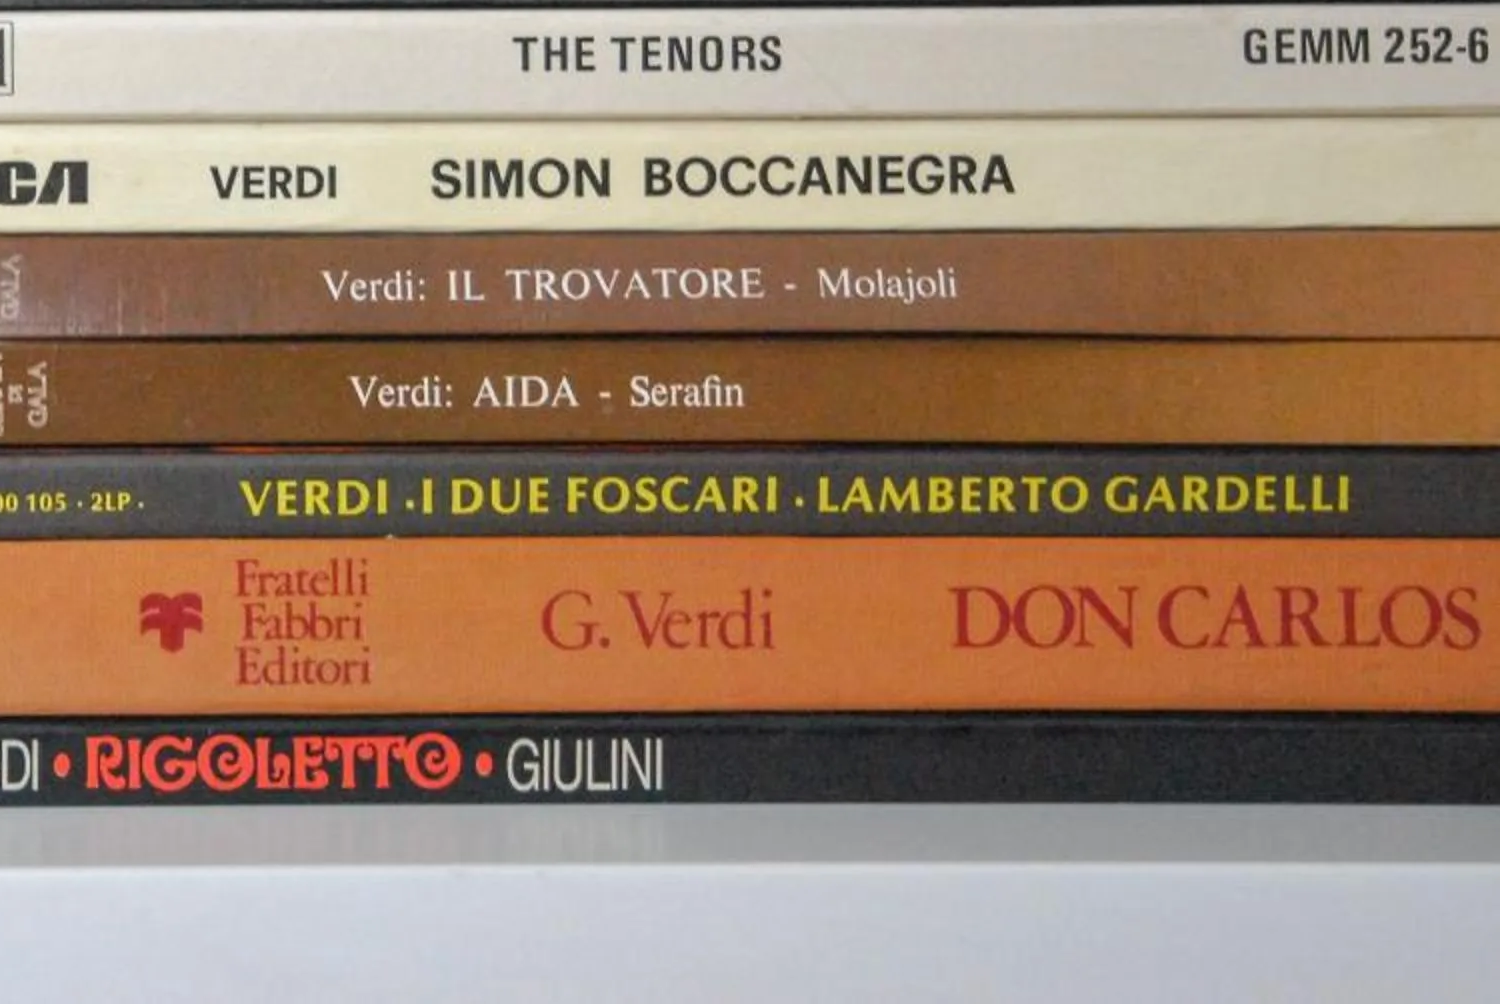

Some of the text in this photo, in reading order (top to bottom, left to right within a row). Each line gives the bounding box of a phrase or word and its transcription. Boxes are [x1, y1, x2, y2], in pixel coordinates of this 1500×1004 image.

[512, 27, 1490, 73] THE TENORS GEMM 252-6
[210, 155, 1016, 200] VERDI SIMON BOCCANEGRA
[1, 254, 23, 319] GALA
[322, 267, 958, 305] Verdi: IL TROVATORE Molajoli
[27, 361, 48, 428] GALA
[349, 374, 745, 410] Verdi: AIDA Serafin
[26, 491, 67, 514] 105
[89, 491, 131, 513] 2LP
[239, 479, 389, 518] VERDI
[441, 478, 549, 516] DUE
[565, 476, 778, 514] FOSCARI
[818, 475, 1089, 515] LAMBERTO
[1105, 475, 1352, 513] GARDELLI
[235, 558, 369, 597] Fratelli
[243, 602, 364, 642] Fabbri
[541, 584, 1482, 651] G. Verdi DON CARLOS
[235, 647, 372, 687] Editori
[85, 733, 462, 791] RIGOLETTO
[507, 737, 664, 792] GIULINI
